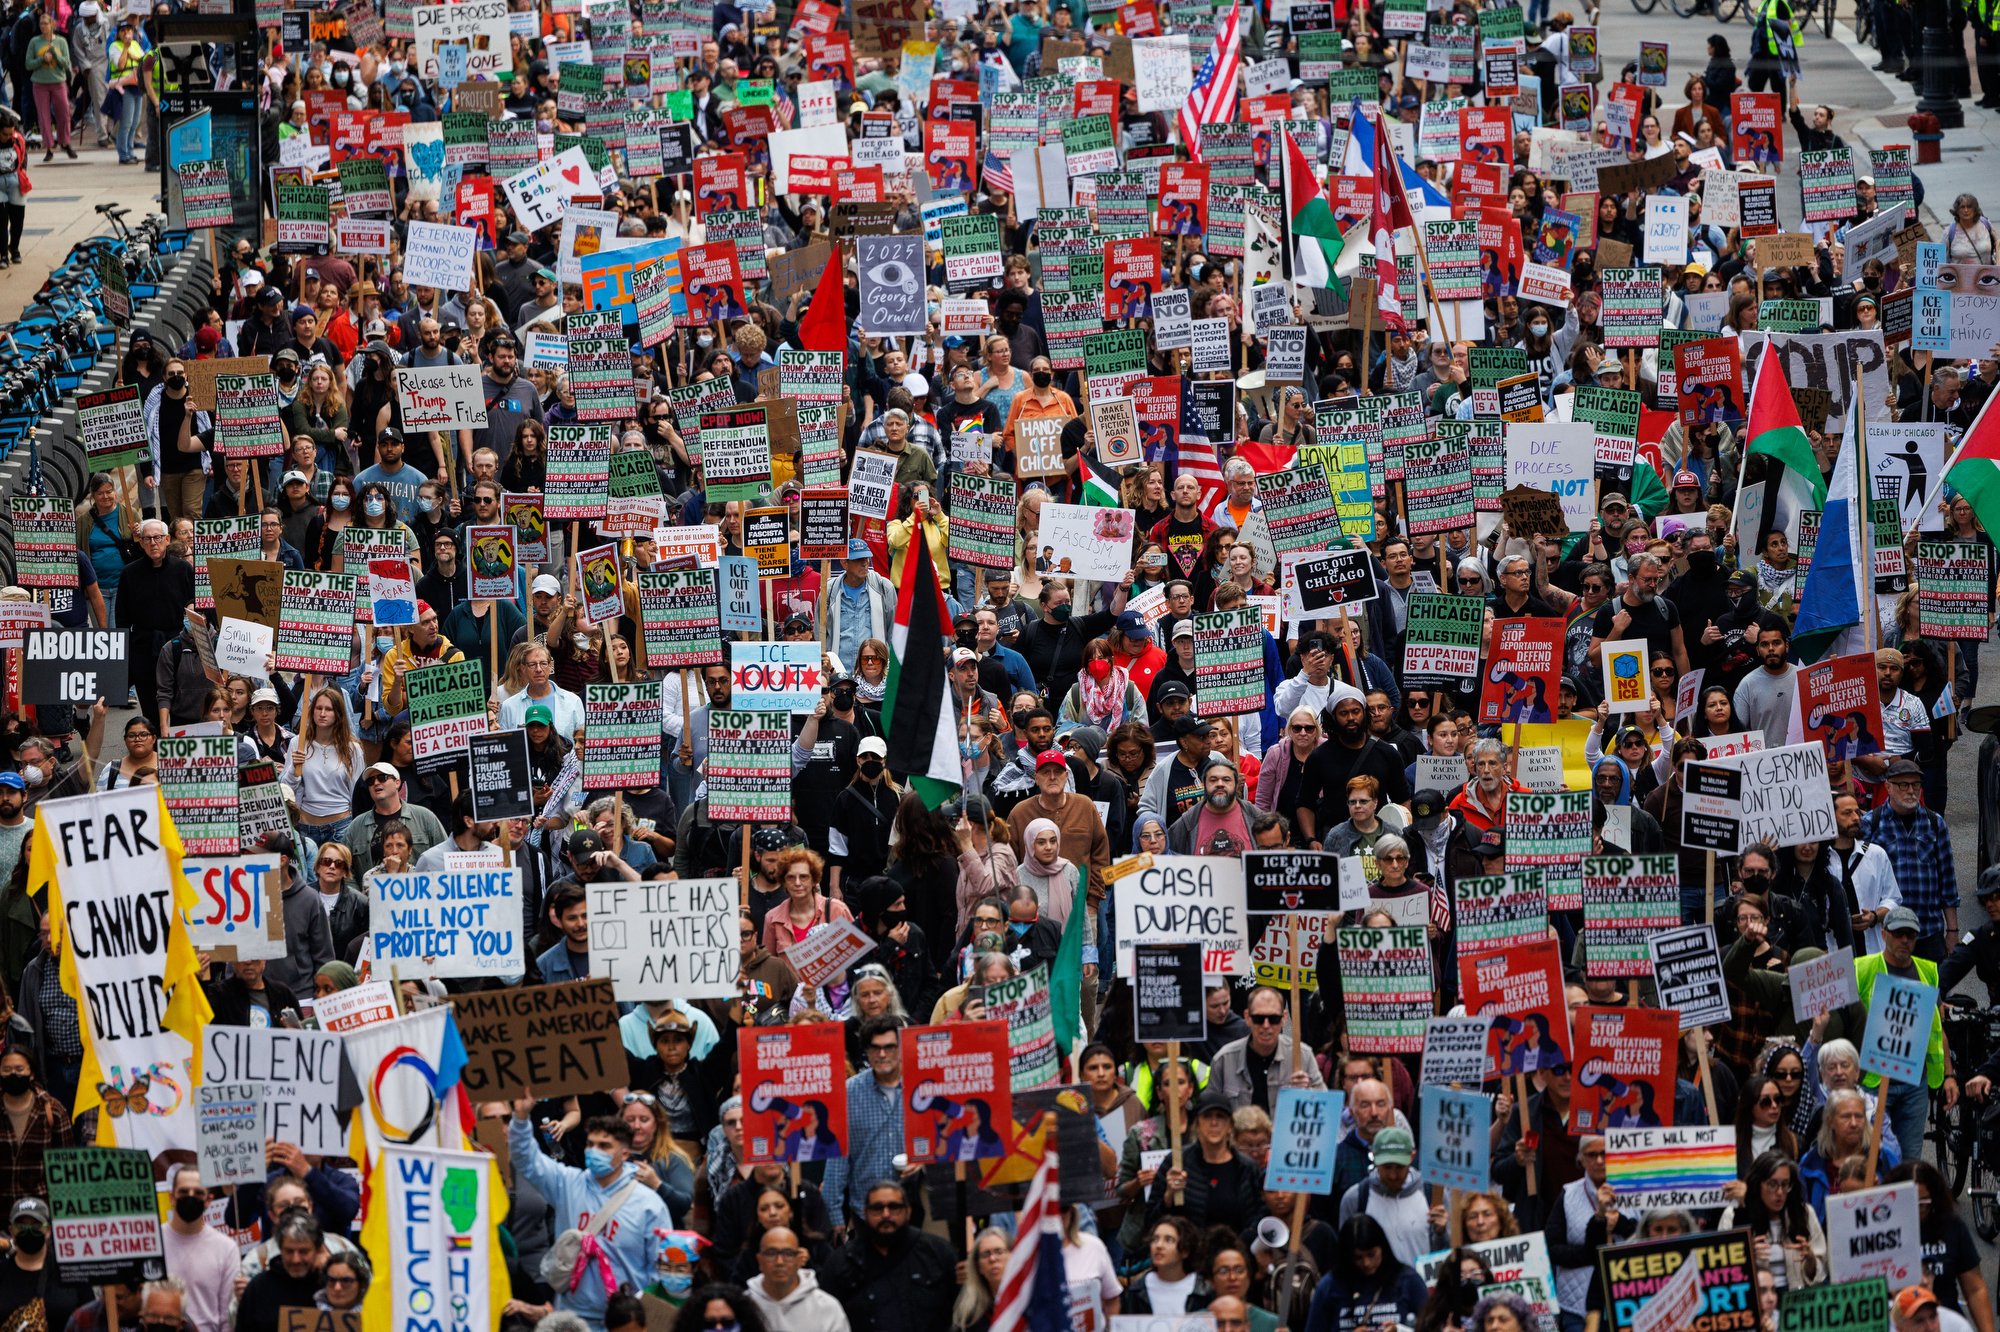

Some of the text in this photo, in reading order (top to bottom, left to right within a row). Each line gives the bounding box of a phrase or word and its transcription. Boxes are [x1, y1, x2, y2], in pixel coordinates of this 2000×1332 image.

[418, 3, 507, 27] DUE PROCESS
[460, 90, 493, 108] PROTECT
[1063, 120, 1110, 139] CHICAGO
[877, 140, 893, 148] OUT
[857, 150, 900, 159] CHICAGO
[1802, 149, 1850, 163] STOP THE
[280, 194, 327, 204] CHICAGO
[280, 211, 327, 220] PALESTINE
[924, 203, 966, 221] NO TRUMP
[280, 224, 326, 232] OCCUPATION
[412, 226, 472, 244] VETERANS
[409, 242, 468, 258] DEMAND NO
[866, 243, 917, 262] 2025
[1771, 250, 1803, 261] NO USA
[408, 255, 451, 272] TROOPS
[423, 270, 468, 289] STREETS
[868, 286, 916, 305] George
[1153, 293, 1187, 307] DECIMOS
[1923, 296, 1941, 308] ICE
[872, 309, 920, 326] Orwell
[1155, 304, 1189, 318] NO
[1760, 308, 1818, 322] CHICAGO
[1921, 308, 1942, 318] OUT
[1921, 326, 1941, 335] CHI
[400, 372, 473, 392] Release the
[407, 391, 447, 416] Trump
[456, 400, 487, 423] Files
[1102, 404, 1124, 415] MAKE
[701, 411, 764, 427] CPOP NOW!
[1098, 414, 1130, 422] ORWELL
[1101, 421, 1130, 430] FICTION
[702, 427, 765, 440] SUPPORT THE
[1021, 419, 1063, 436] HANDS
[1105, 428, 1129, 437] AGAIN
[704, 437, 766, 450] REFERENDUM
[1030, 437, 1056, 453] OFF
[1531, 441, 1561, 455] DUE
[706, 455, 768, 468] OVER POLICE
[1515, 461, 1573, 475] PROCESS
[1877, 457, 1894, 472] ICE
[854, 484, 885, 498] WE NEED
[1551, 479, 1589, 496] NOT
[749, 530, 784, 538] FASCISTA
[750, 522, 783, 530] RÉGIMEN
[761, 537, 784, 545] TRUMP
[1091, 558, 1121, 576] Sweaty
[1410, 605, 1481, 622] CHICAGO
[223, 626, 251, 642] Small
[1408, 630, 1478, 645] PALESTINE
[1501, 631, 1524, 641] STOP
[28, 632, 125, 660] ABOLISH
[759, 646, 791, 661] ICE
[1500, 642, 1552, 650] DEPORTATIONS
[1517, 651, 1551, 662] DEFEND
[1497, 661, 1550, 672] IMMIGRANTS
[742, 663, 807, 691] OUT
[1618, 679, 1638, 689] NO
[60, 672, 97, 700] ICE
[589, 684, 659, 701] STOP THE
[1618, 688, 1639, 699] ICE
[587, 700, 660, 711] TRUMP AGENDA!
[473, 744, 508, 755] THE FALL
[475, 762, 506, 773] TRUMP
[1756, 750, 1823, 785] GERMAN
[476, 771, 510, 782] FASCIST
[477, 780, 512, 791] REGIME
[1780, 785, 1802, 809] DO
[1770, 803, 1835, 839] WE DID!
[59, 809, 159, 867] FEAR
[1262, 856, 1321, 868] ICE OUT
[374, 872, 513, 901] YOUR SILENCE
[1140, 865, 1213, 897] CASA
[1254, 872, 1332, 886] CHICAGO
[594, 883, 729, 914] IF ICE HAS
[66, 891, 170, 958] CANNOT
[391, 905, 489, 928] WILL NOT
[1134, 905, 1238, 935] DUPAGE
[649, 912, 731, 949] HATERS
[375, 929, 512, 959] PROTECT YOU
[602, 957, 619, 982] I
[639, 954, 678, 984] AM
[1671, 956, 1716, 974] MAHMOUD
[1805, 959, 1833, 977] BAN
[1687, 969, 1718, 985] KHALIL
[1799, 967, 1846, 990] TRUMP
[1809, 984, 1837, 1002] AND
[1888, 987, 1919, 1007] ICE
[1884, 1006, 1918, 1027] OUT
[527, 1009, 619, 1042] AMERICA
[1877, 1035, 1911, 1058] CHI
[461, 1037, 607, 1090] GREAT
[201, 1085, 253, 1103] STFU
[202, 1120, 255, 1134] CHICAGO
[1609, 1129, 1718, 1148] HATE WILL NOT
[204, 1142, 258, 1158] ABOLISH
[50, 1159, 148, 1184] CHICAGO
[53, 1196, 153, 1217] PALESTINE
[1645, 1192, 1695, 1206] AMERICA
[56, 1221, 156, 1238] OCCUPATION
[1850, 1229, 1902, 1258] KINGS!
[1610, 1243, 1746, 1280] KEEP THE
[1783, 1299, 1887, 1331] CHICAGO
